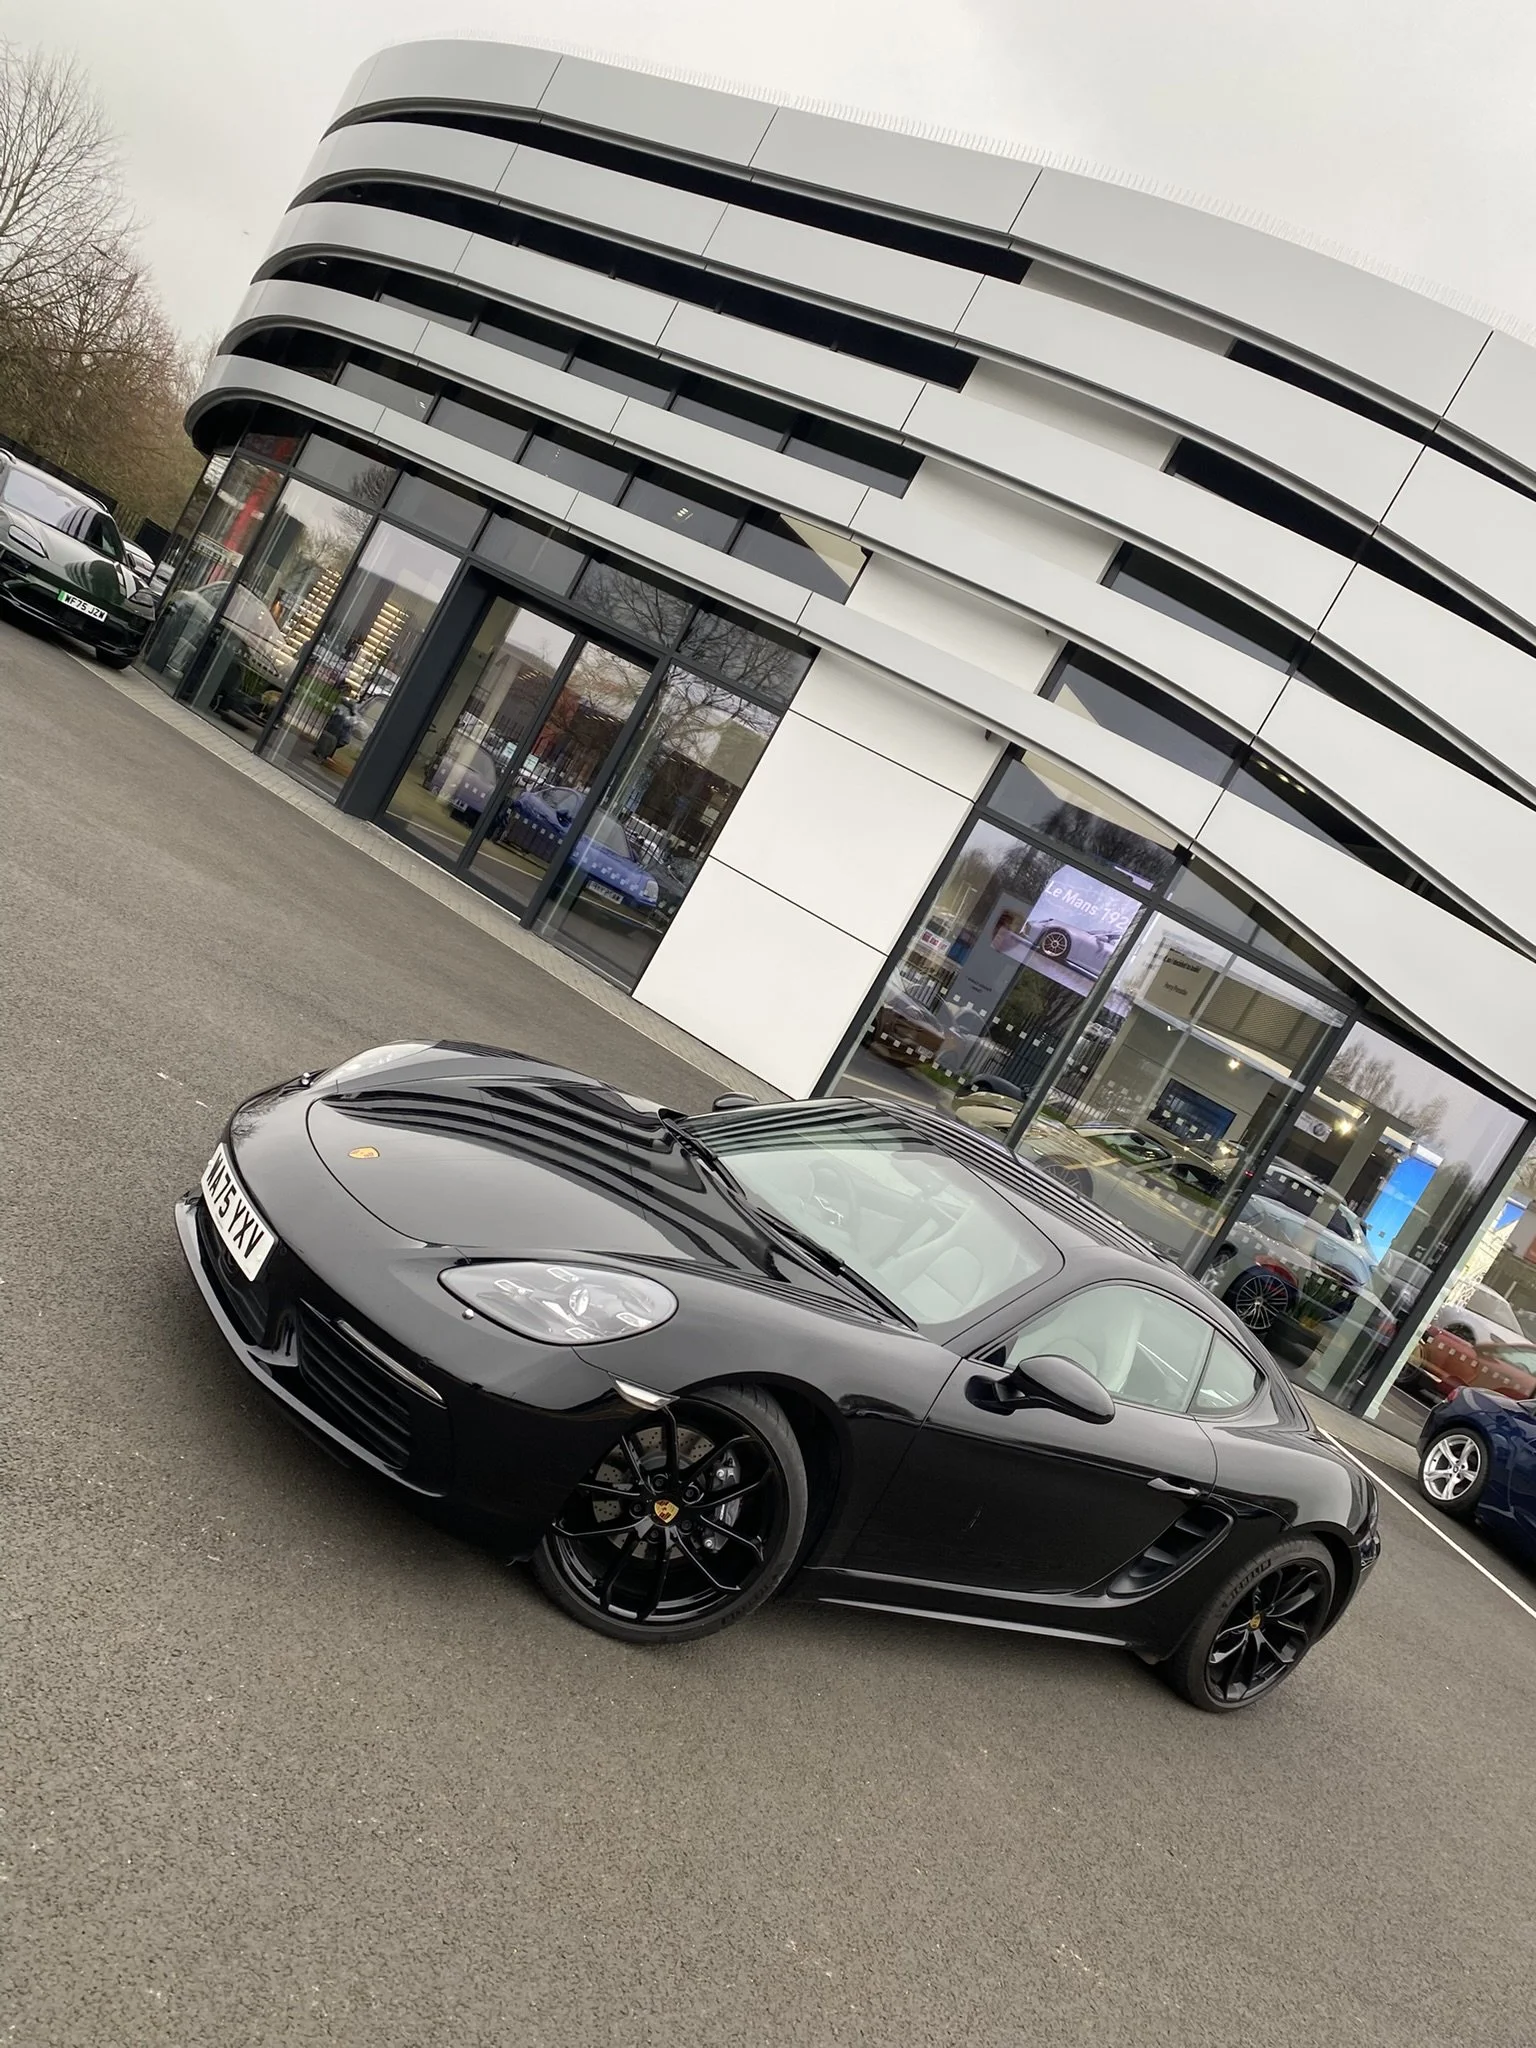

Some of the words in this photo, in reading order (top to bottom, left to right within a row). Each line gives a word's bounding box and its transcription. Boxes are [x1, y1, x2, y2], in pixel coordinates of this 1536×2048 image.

[1045, 880, 1063, 897] Le
[1062, 889, 1098, 916] Mans
[227, 1198, 264, 1259] YXV
